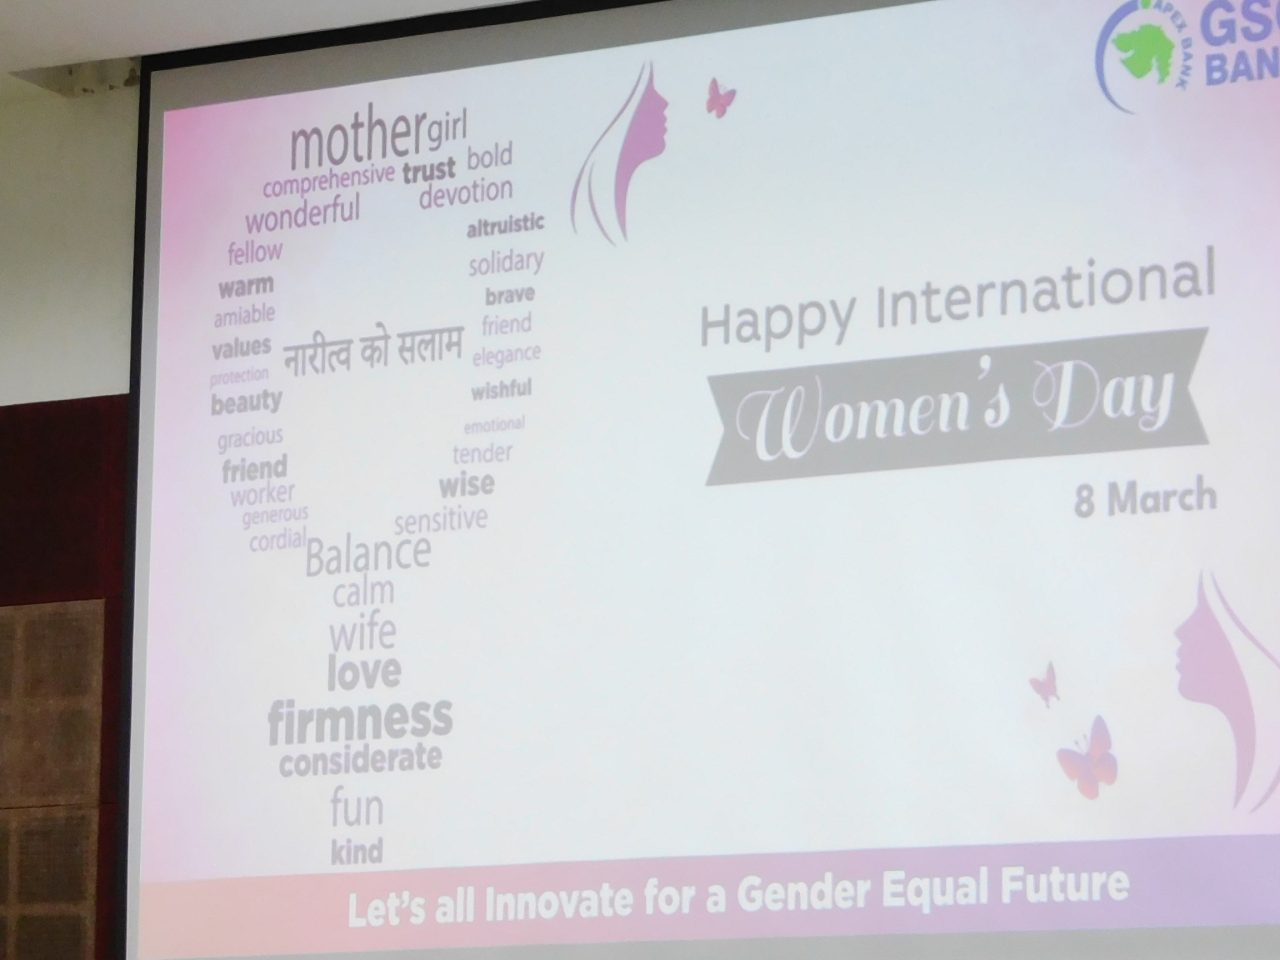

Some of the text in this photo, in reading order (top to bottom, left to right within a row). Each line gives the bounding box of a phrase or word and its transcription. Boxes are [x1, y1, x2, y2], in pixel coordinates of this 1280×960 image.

[1175, 36, 1193, 91] BANK
[290, 102, 467, 171] mother girl
[263, 141, 512, 199] comprehensive trust bold
[245, 177, 512, 235] wonderful devotion
[466, 212, 545, 240] altruistic
[228, 239, 283, 266] fellow
[469, 247, 545, 278] solidary
[219, 274, 274, 300] warm
[485, 285, 535, 306] brave
[701, 245, 1216, 352] Happy International
[214, 304, 276, 329] amiable
[481, 312, 532, 337] friend
[212, 335, 272, 361] values
[283, 321, 465, 377] नारीत्व को सलाम
[472, 343, 542, 369] elegance
[210, 366, 269, 388] protection
[471, 378, 532, 402] wishful
[210, 387, 283, 416] beauty
[1033, 359, 1175, 433] Day
[464, 415, 525, 435] emotional
[218, 426, 283, 455] gracious
[453, 442, 513, 465] tender
[222, 454, 287, 483] friend
[230, 481, 295, 507] worker
[439, 471, 495, 499] wise
[1074, 474, 1218, 518] 8 March
[242, 505, 309, 530] generous
[394, 504, 488, 536] sensitive
[249, 526, 307, 552] cordial
[306, 532, 431, 577] Balance
[333, 573, 394, 607] calm
[329, 609, 397, 653] wife
[327, 654, 402, 692] love
[267, 699, 454, 746] firmness
[279, 742, 442, 778] considerate
[331, 785, 383, 828] fun
[331, 837, 383, 865] kind
[435, 886, 474, 923] all
[486, 882, 634, 922] Innovate
[644, 878, 696, 915] for
[706, 884, 726, 914] a
[737, 872, 871, 912] Gender
[883, 866, 988, 914] Equal
[1002, 865, 1131, 904] Future
